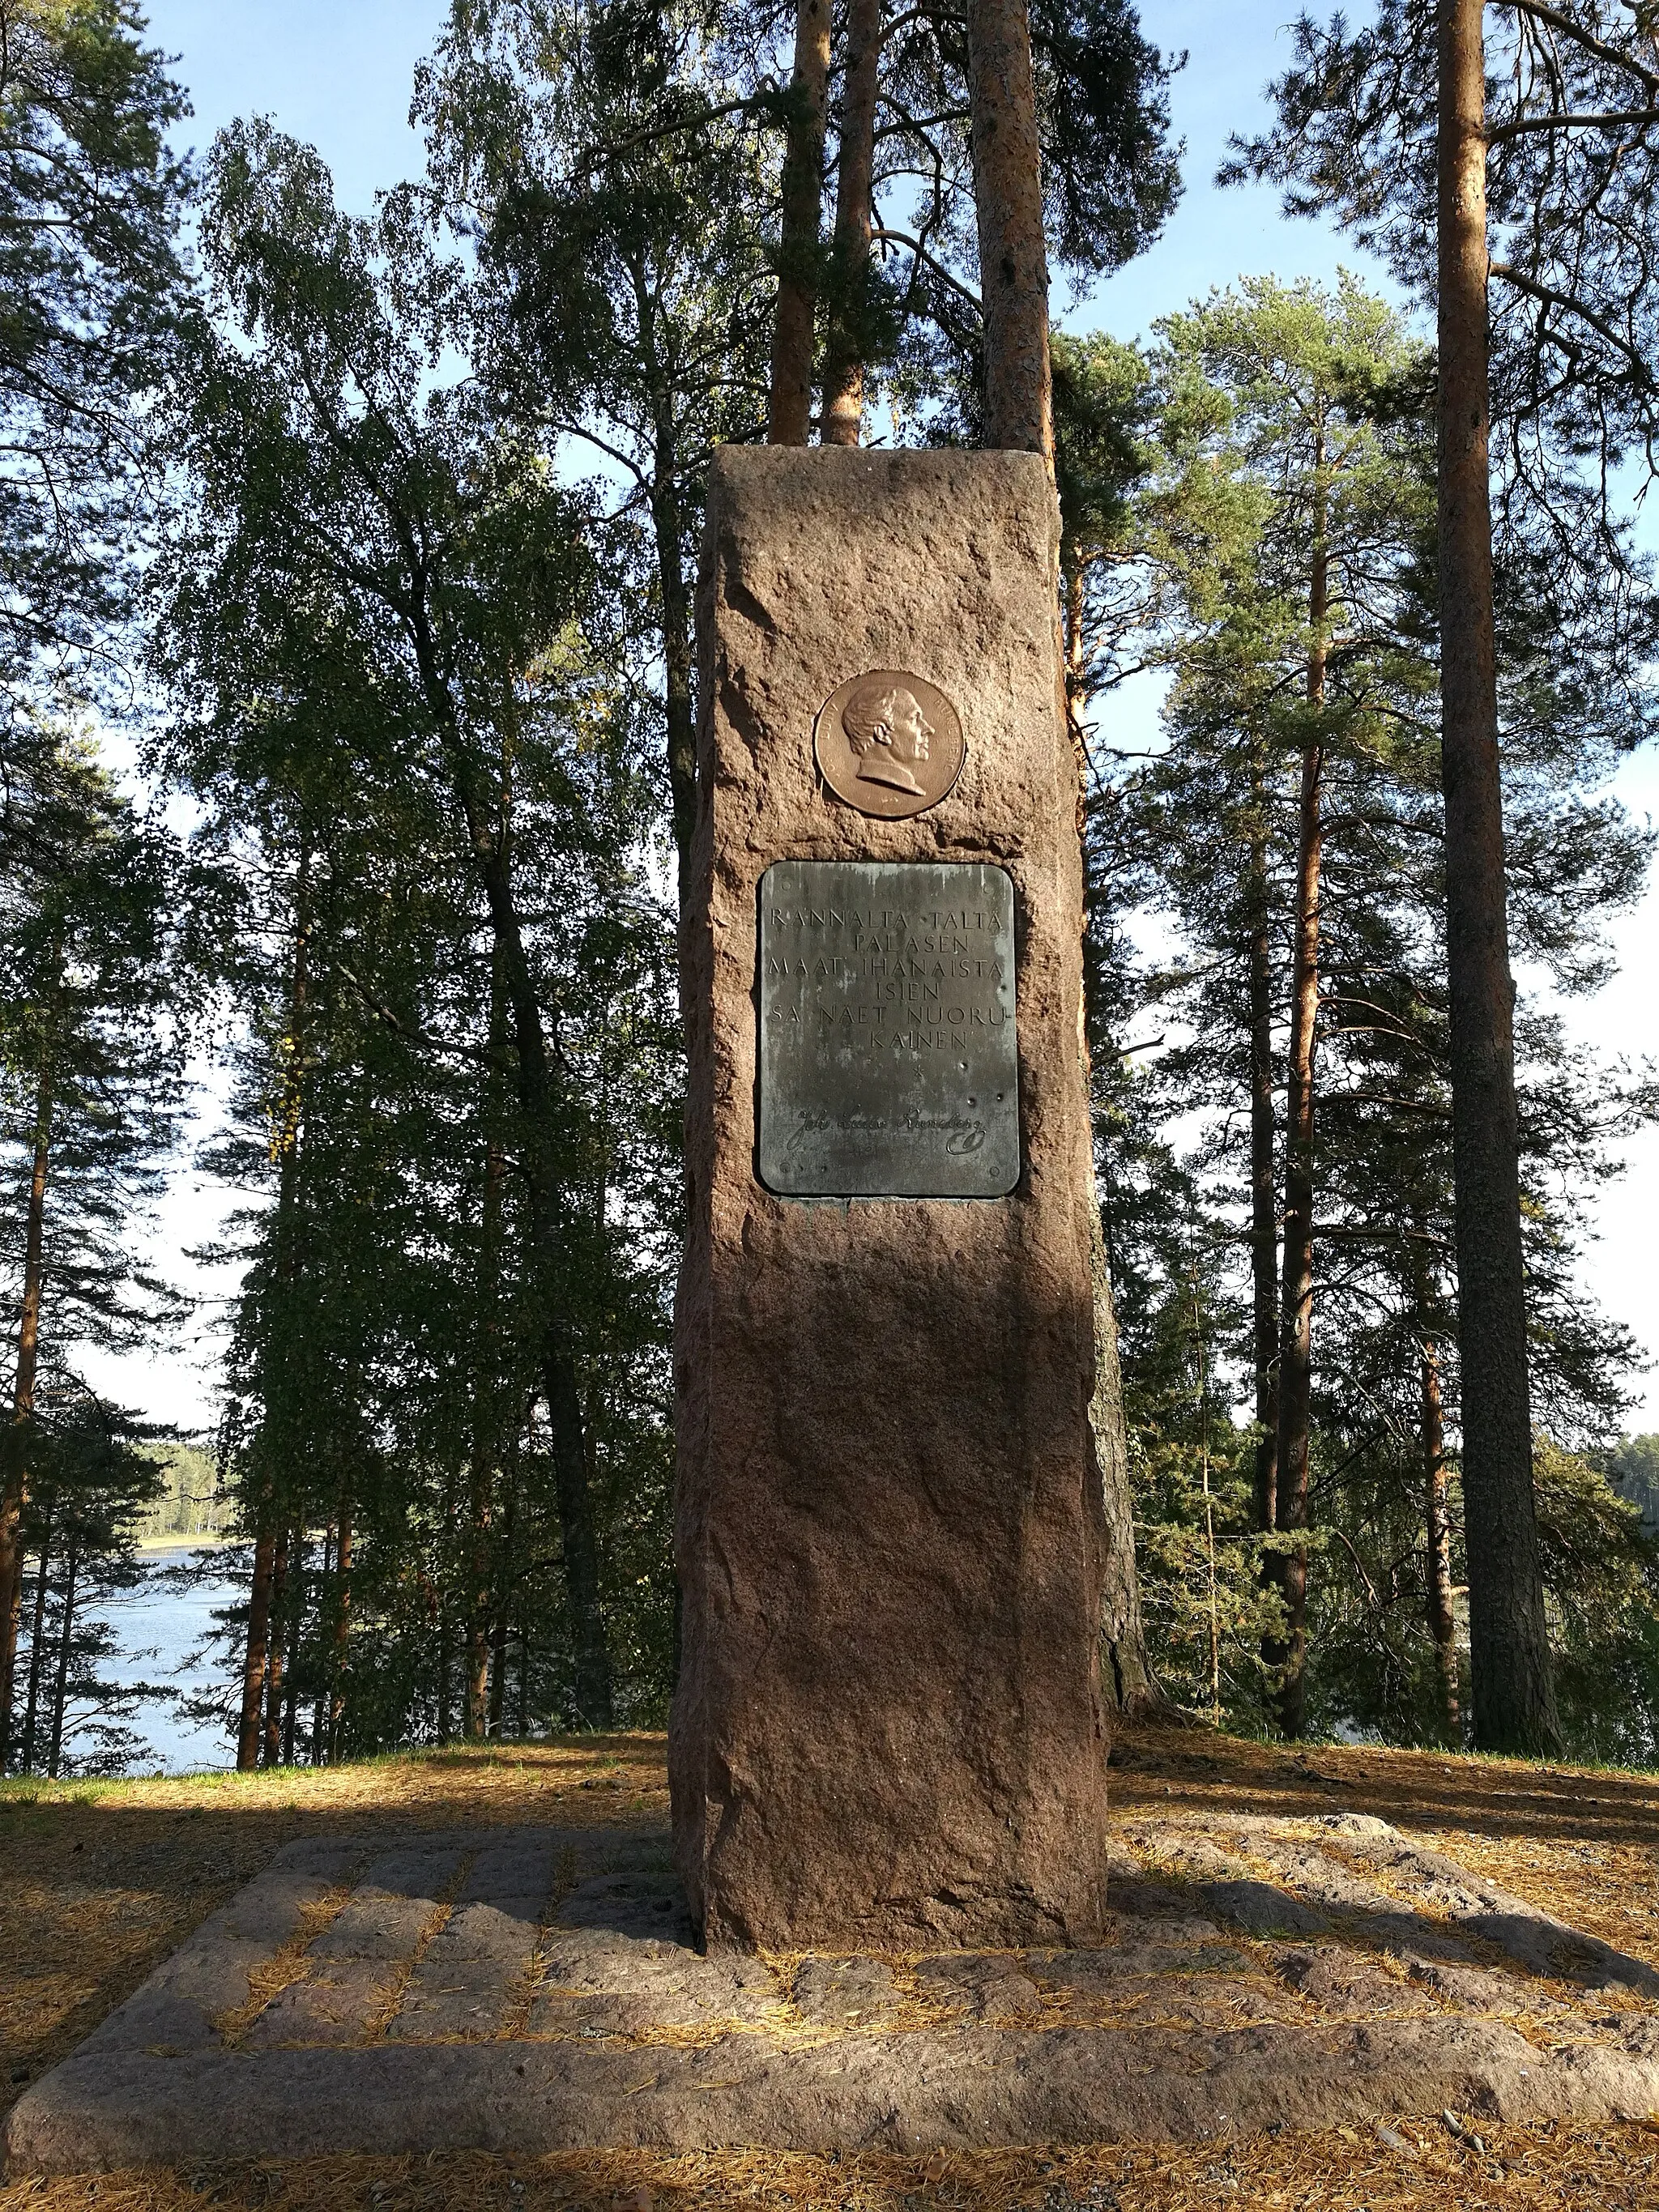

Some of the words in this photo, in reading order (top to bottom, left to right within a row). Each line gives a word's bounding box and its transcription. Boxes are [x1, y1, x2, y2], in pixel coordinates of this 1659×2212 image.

[854, 935, 970, 953] PALASEN
[863, 959, 1004, 978] IHANAISTA
[876, 982, 939, 1001] ISIEN
